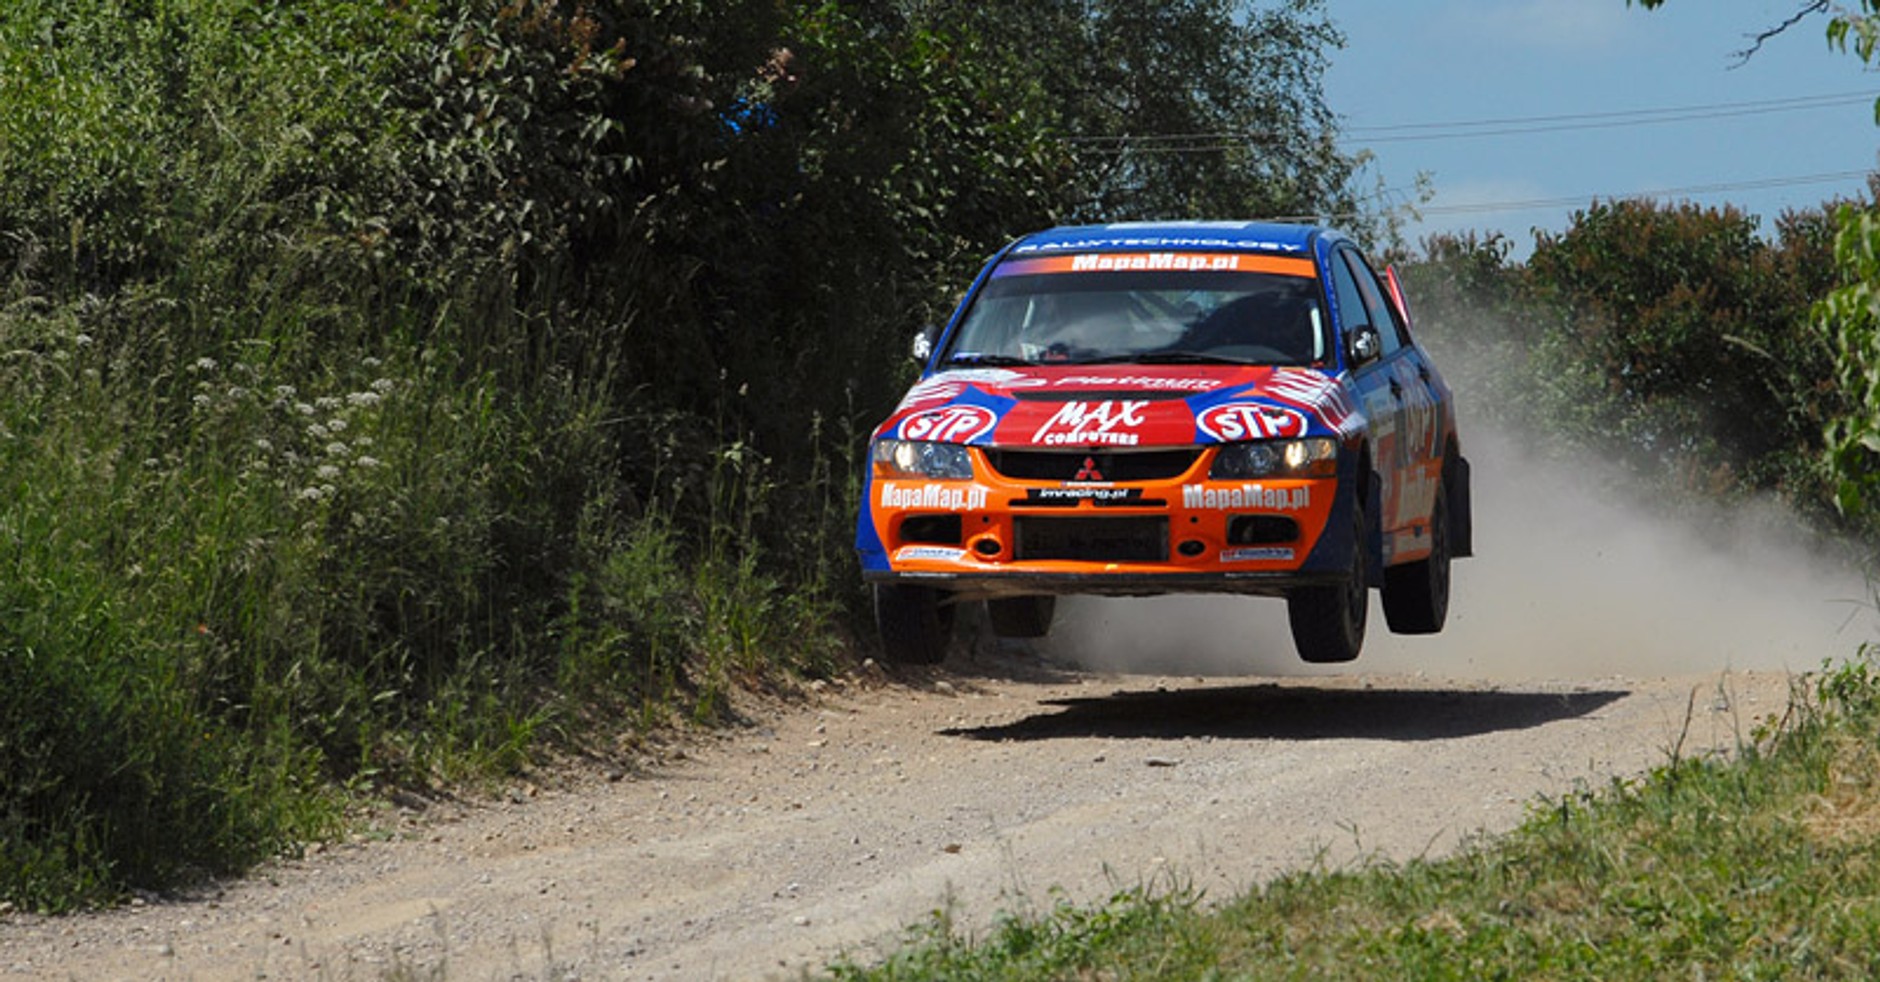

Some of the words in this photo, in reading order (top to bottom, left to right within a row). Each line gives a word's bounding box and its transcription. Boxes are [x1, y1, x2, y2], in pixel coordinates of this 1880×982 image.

[1071, 253, 1239, 271] MapaMap.pl
[906, 408, 981, 443] STP
[1032, 400, 1149, 443] MAX
[1215, 406, 1292, 439] STP
[1044, 431, 1138, 445] COMPUTERS
[881, 483, 987, 511] MapaMap.pl
[1183, 484, 1310, 509] MapaMap.pl
